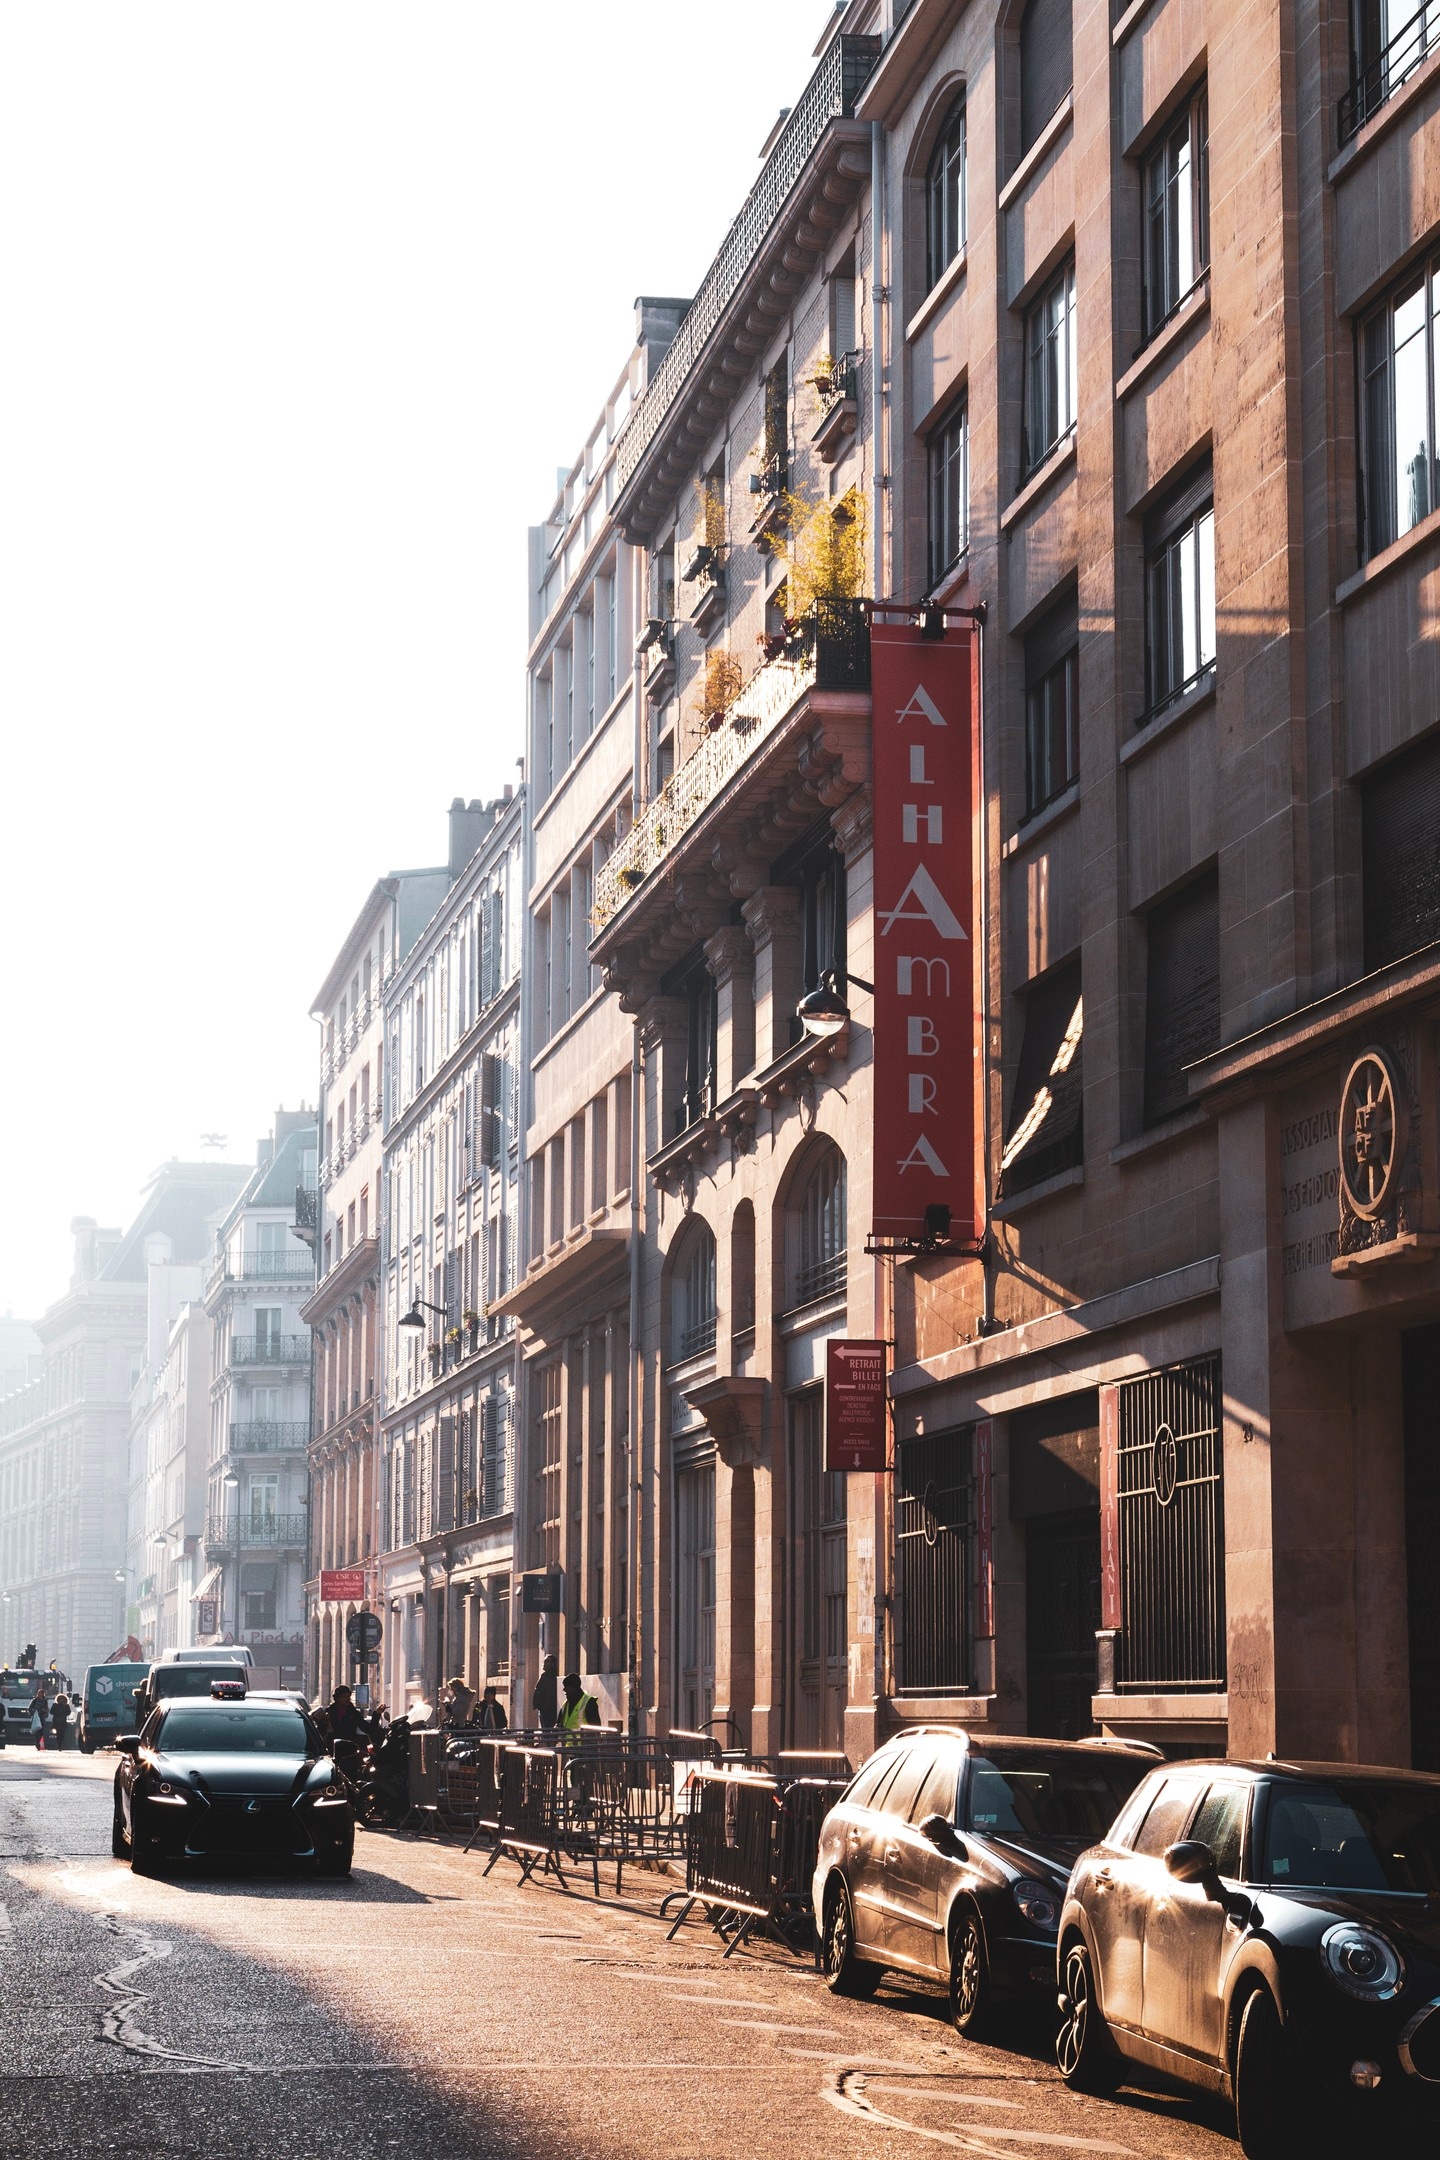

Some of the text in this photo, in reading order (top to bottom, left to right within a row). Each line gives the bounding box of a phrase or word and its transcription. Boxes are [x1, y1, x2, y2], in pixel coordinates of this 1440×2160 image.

[849, 1359, 881, 1369] RETRAIT
[852, 1371, 881, 1381] BILLET
[858, 1383, 882, 1391] EN FACE
[1105, 1404, 1116, 1615] RESTAURANT
[224, 1631, 245, 1644] Au
[250, 1631, 285, 1644] Pied
[219, 1683, 241, 1691] TAXI
